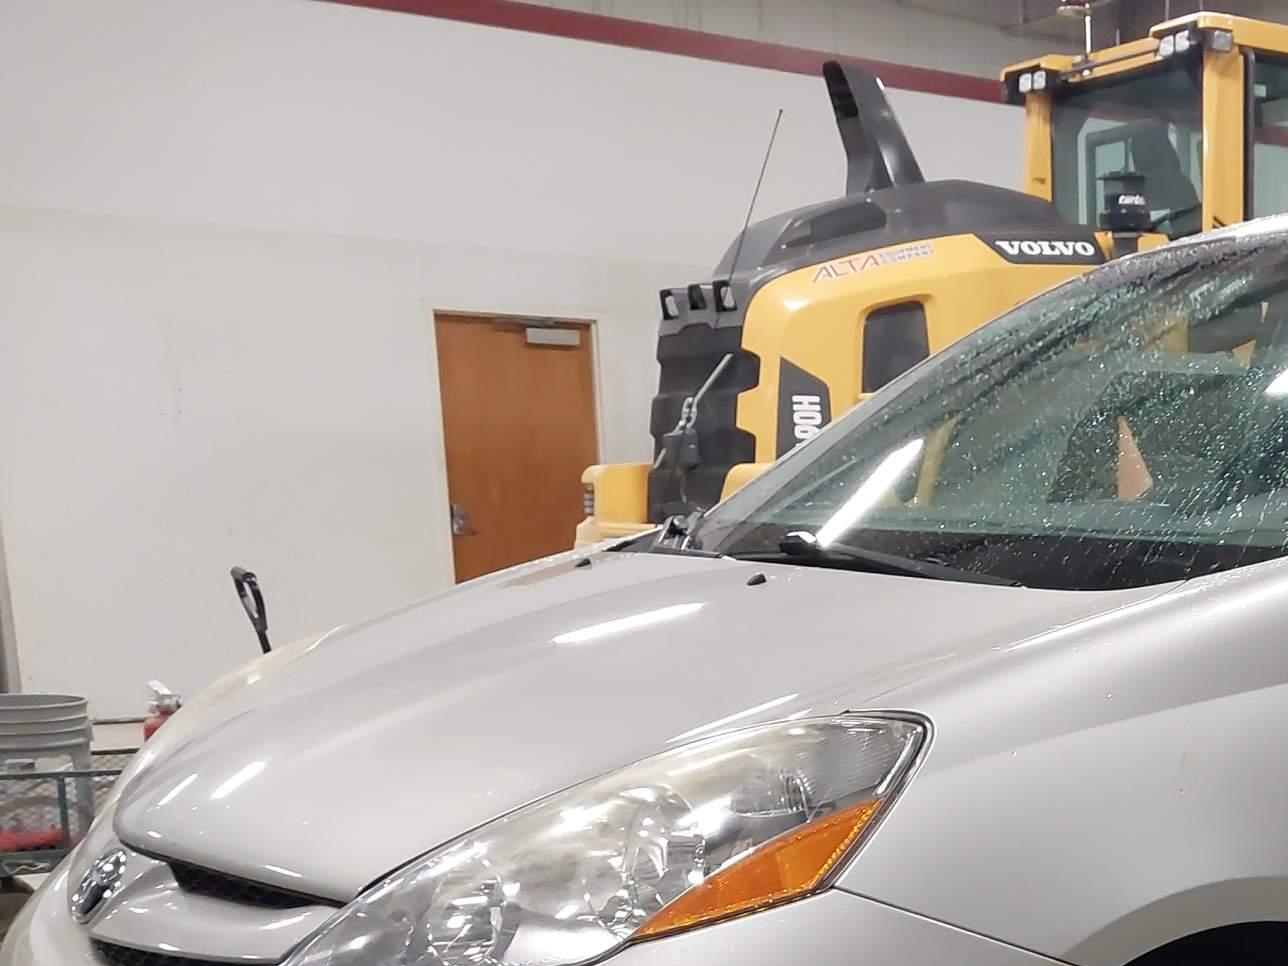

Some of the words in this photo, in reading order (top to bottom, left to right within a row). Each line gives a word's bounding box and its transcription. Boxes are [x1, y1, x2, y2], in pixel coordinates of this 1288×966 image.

[995, 240, 1095, 256] VOLVO
[812, 254, 880, 283] ALTA
[792, 395, 822, 446] 90H
